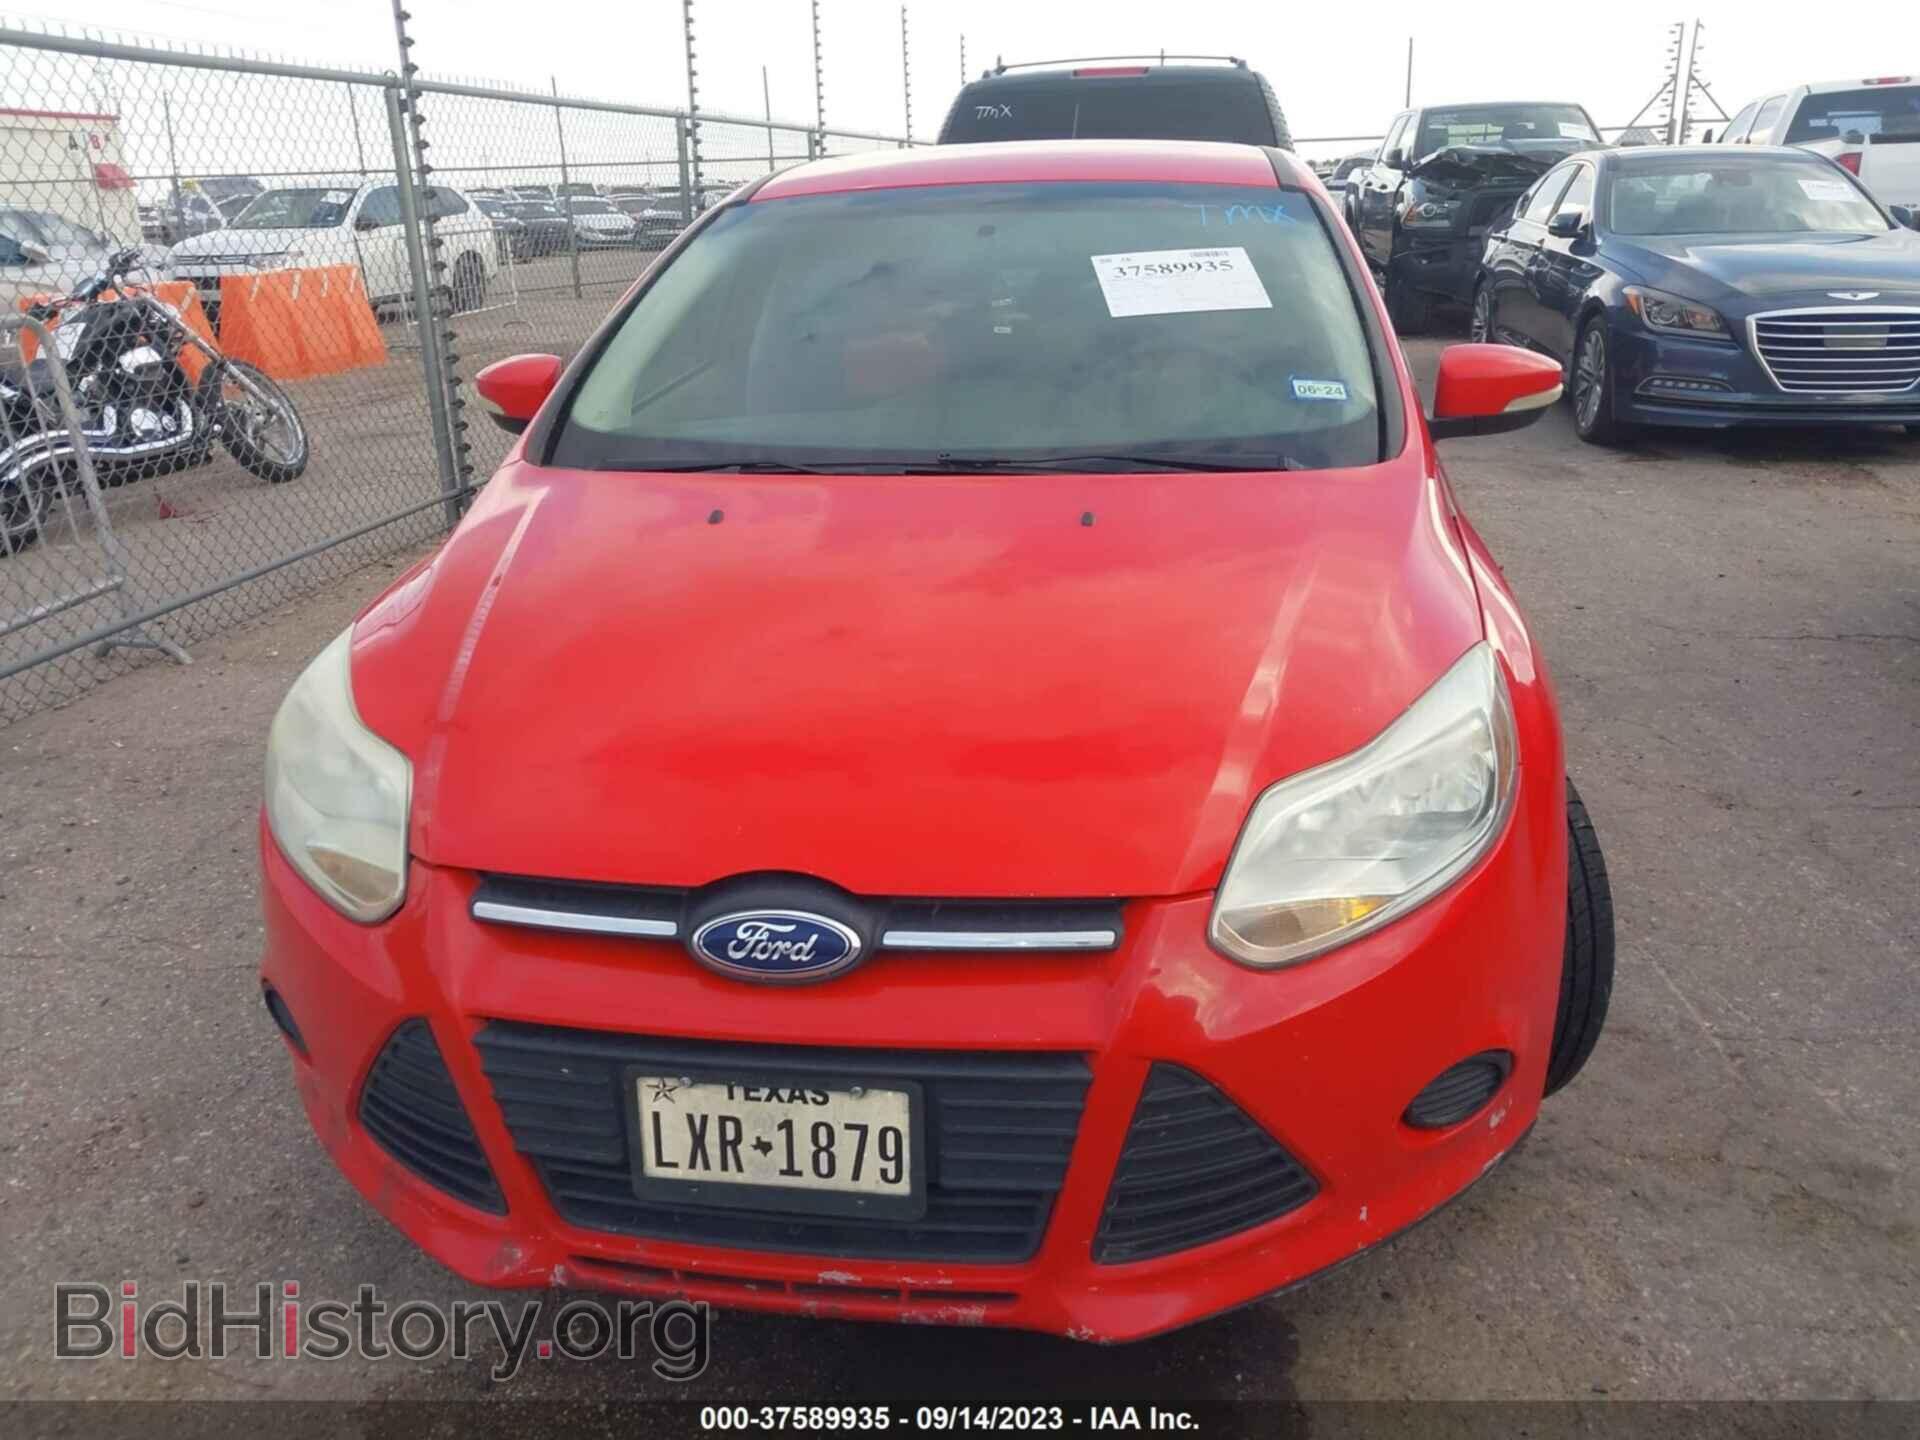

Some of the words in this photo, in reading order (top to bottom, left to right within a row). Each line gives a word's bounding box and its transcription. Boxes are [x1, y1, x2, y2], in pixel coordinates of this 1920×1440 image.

[1112, 259, 1233, 279] 37589935
[727, 920, 819, 961] Ford
[652, 1110, 745, 1174] LXR
[776, 1118, 904, 1185] 1879
